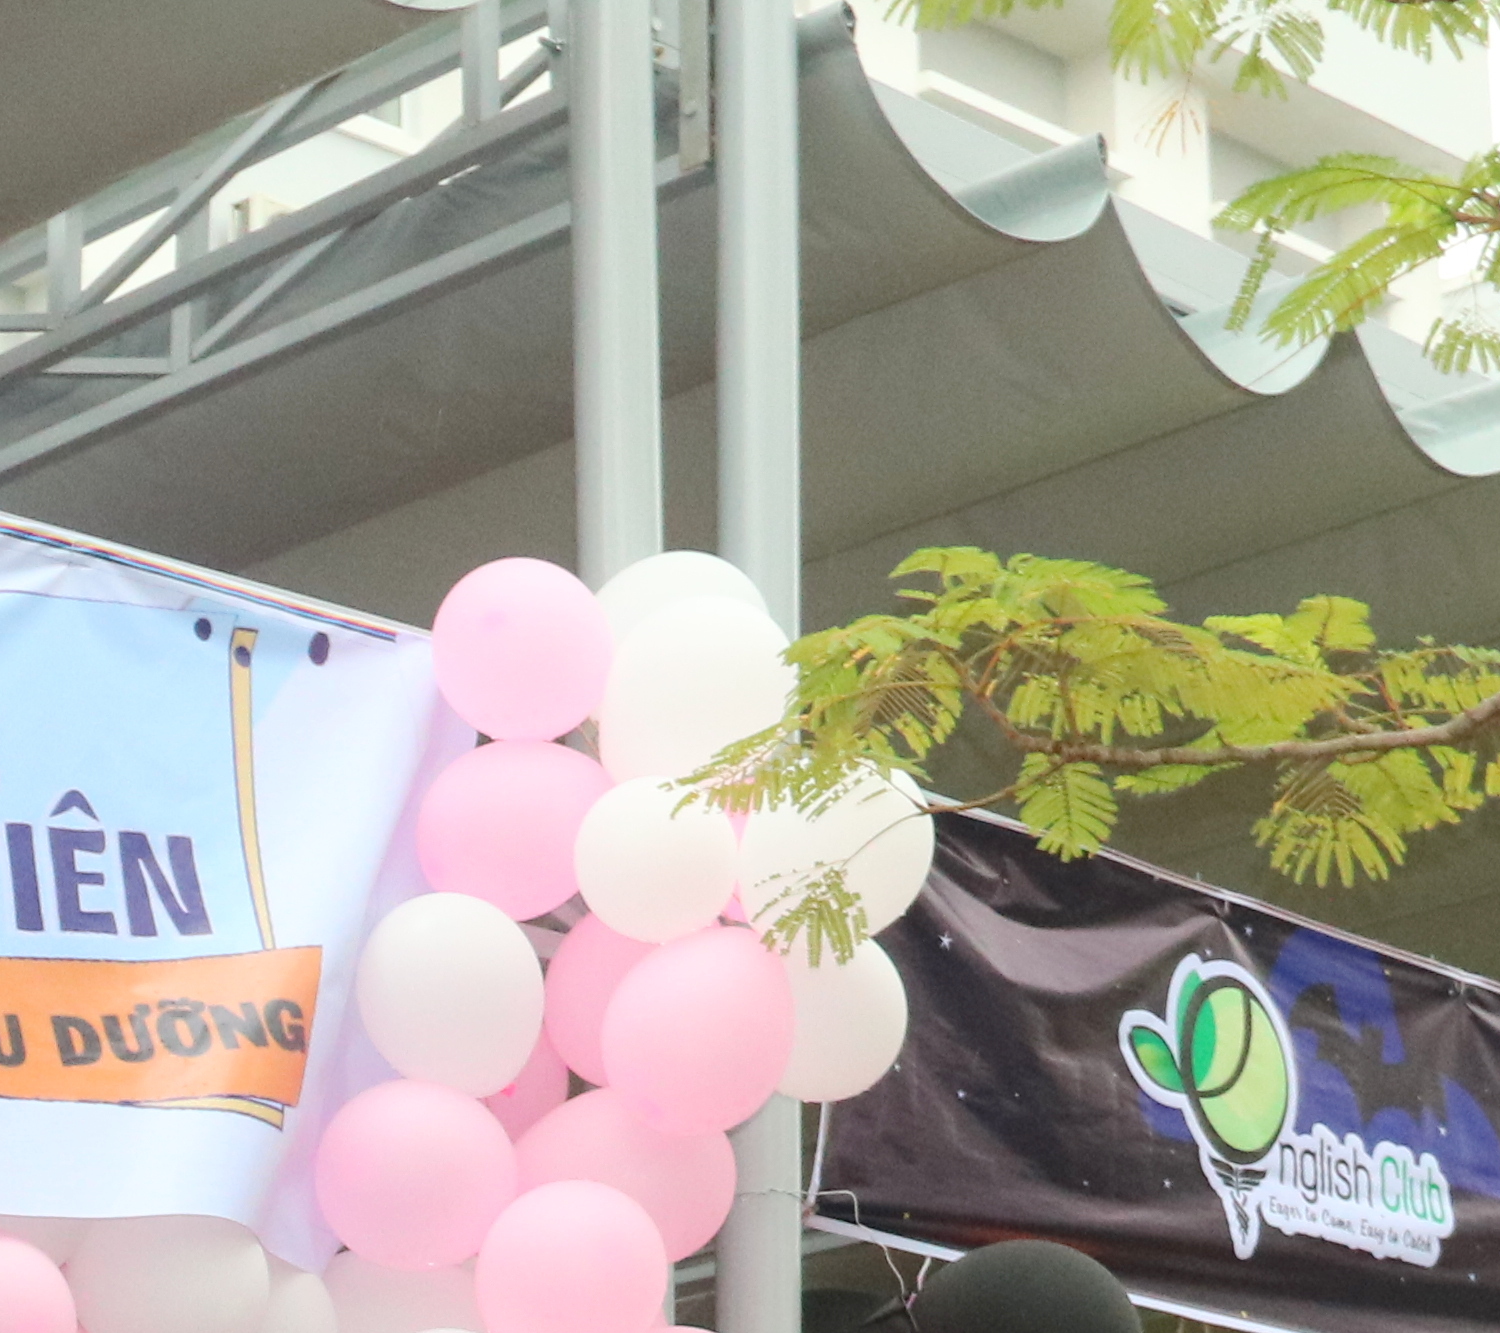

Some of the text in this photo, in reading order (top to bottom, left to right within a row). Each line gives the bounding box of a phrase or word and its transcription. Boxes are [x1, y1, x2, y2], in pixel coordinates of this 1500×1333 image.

[53, 997, 308, 1069] DƯỠNG
[1380, 1155, 1446, 1225] Club
[1304, 1205, 1318, 1223] to
[1359, 1218, 1386, 1246] Easy
[1387, 1227, 1399, 1244] to
